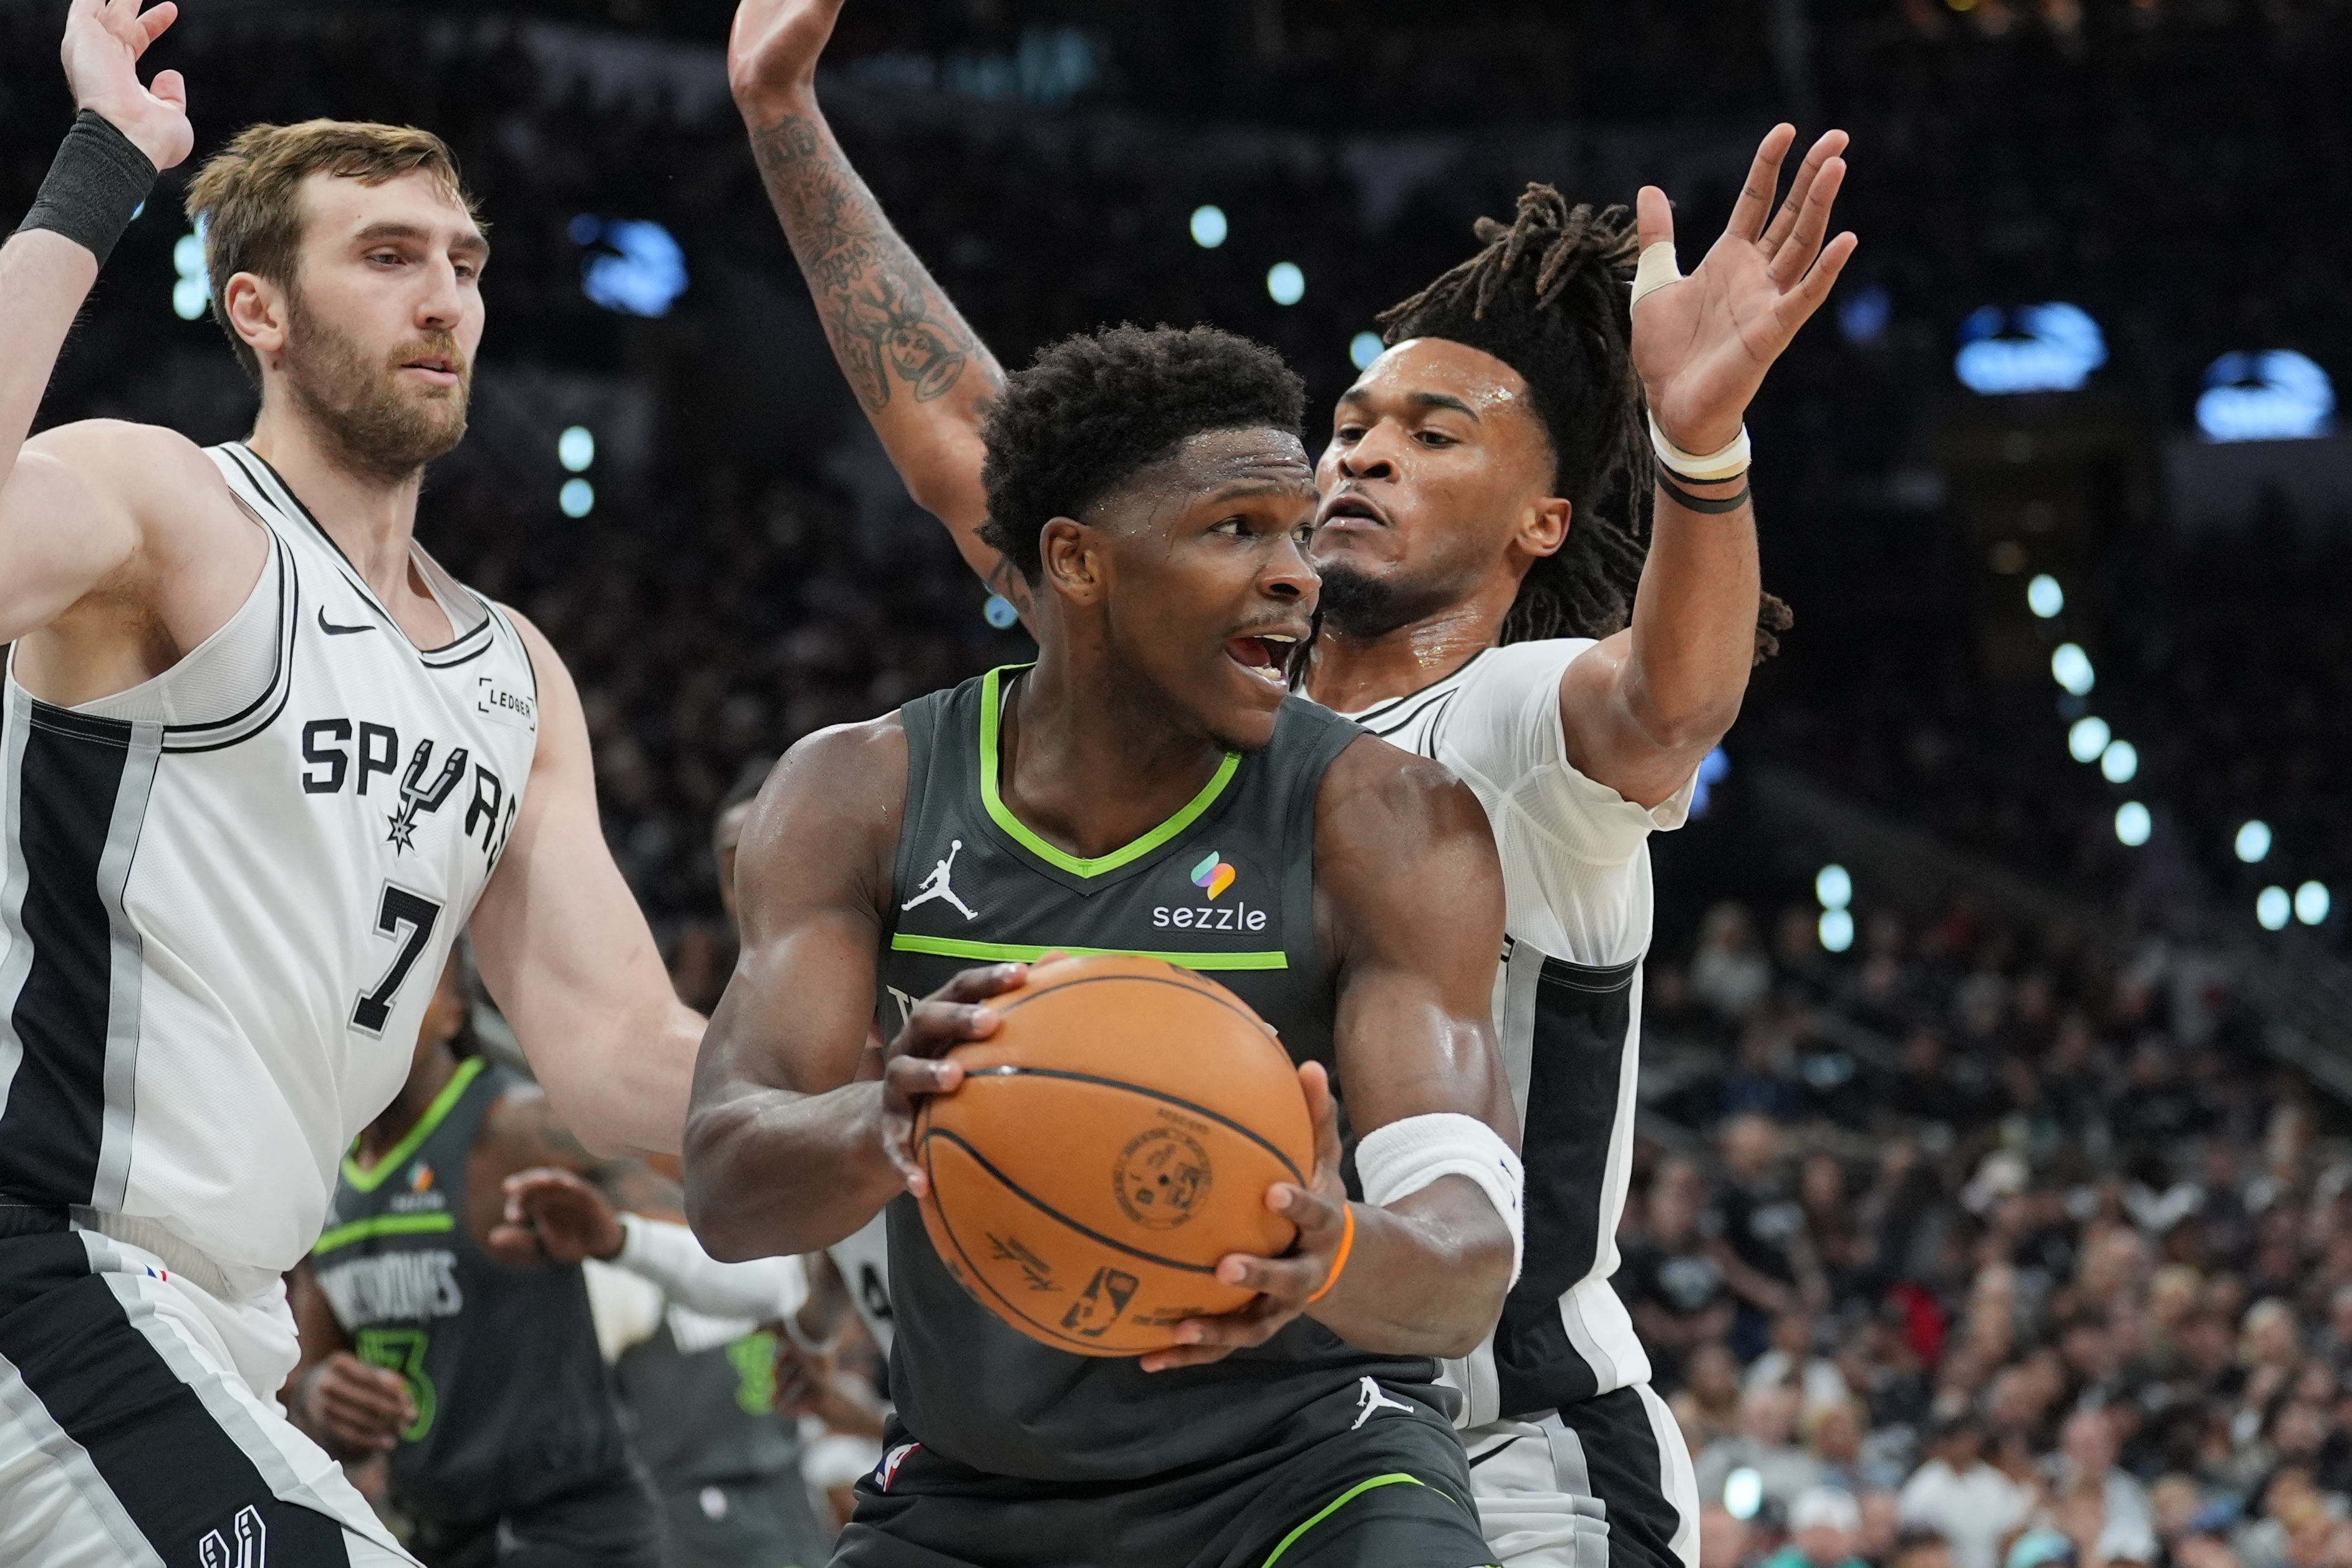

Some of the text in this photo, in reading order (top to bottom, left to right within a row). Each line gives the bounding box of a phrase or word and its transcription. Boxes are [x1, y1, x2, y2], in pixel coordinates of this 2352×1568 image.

[489, 689, 531, 719] LEDGER
[1153, 902, 1267, 931] sezzle
[346, 877, 446, 1041] 7
